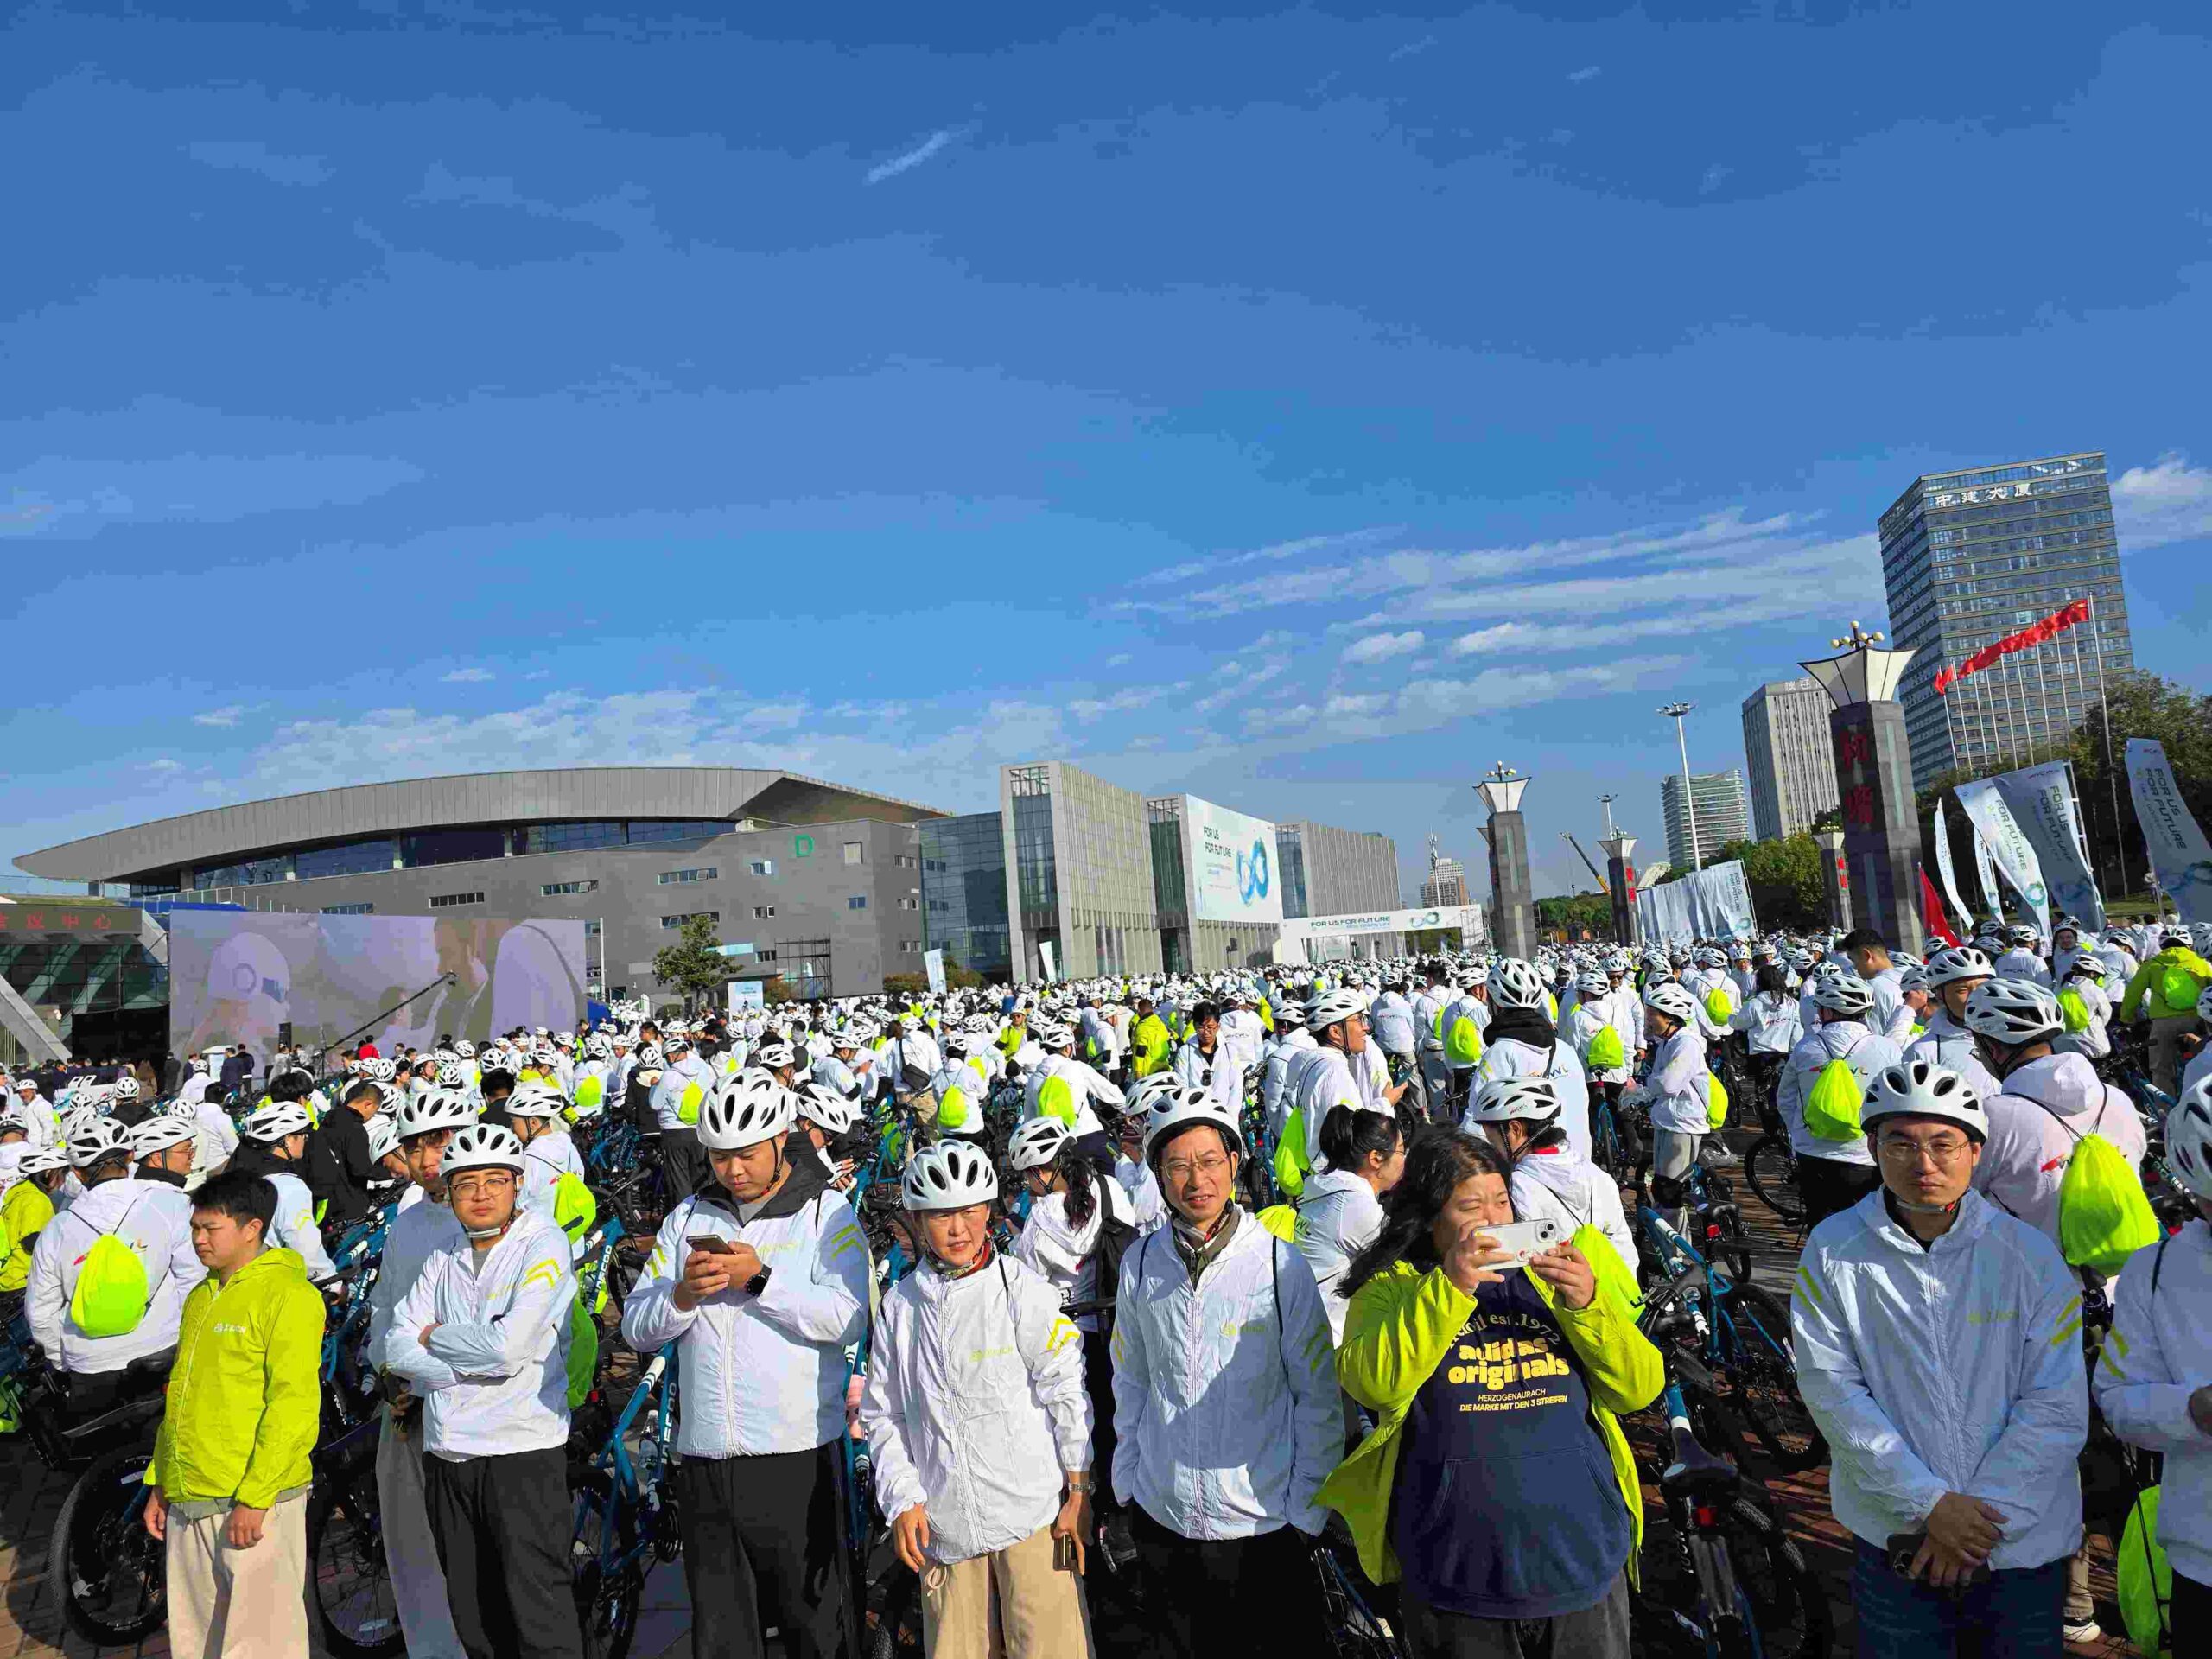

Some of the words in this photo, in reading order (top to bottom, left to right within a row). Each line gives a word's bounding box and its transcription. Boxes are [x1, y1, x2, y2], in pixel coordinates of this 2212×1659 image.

[2037, 788, 2050, 815] FOR
[2050, 785, 2064, 811] FOR
[2154, 768, 2171, 796] FOR
[2166, 798, 2181, 816] US
[2145, 767, 2159, 796] FOR
[2154, 798, 2188, 849] FUTURE
[1203, 826, 1212, 838] FOR
[2056, 813, 2069, 831] US
[796, 835, 815, 857] D
[1995, 798, 2010, 823] FOR
[2005, 823, 2028, 871] FUTURE
[1205, 842, 1214, 854] FOR
[1357, 916, 1390, 925] FUTURE
[1459, 1338, 1549, 1362] adidas
[1448, 1352, 1570, 1390] originals
[1459, 1403, 1472, 1412] DIE
[1472, 1402, 1500, 1411] MARKE
[1500, 1402, 1515, 1411] MIT
[1514, 1400, 1530, 1409] DEN
[1536, 1395, 1568, 1406] STREIFEN
[1478, 1388, 1547, 1402] HERZOGENAURACH
